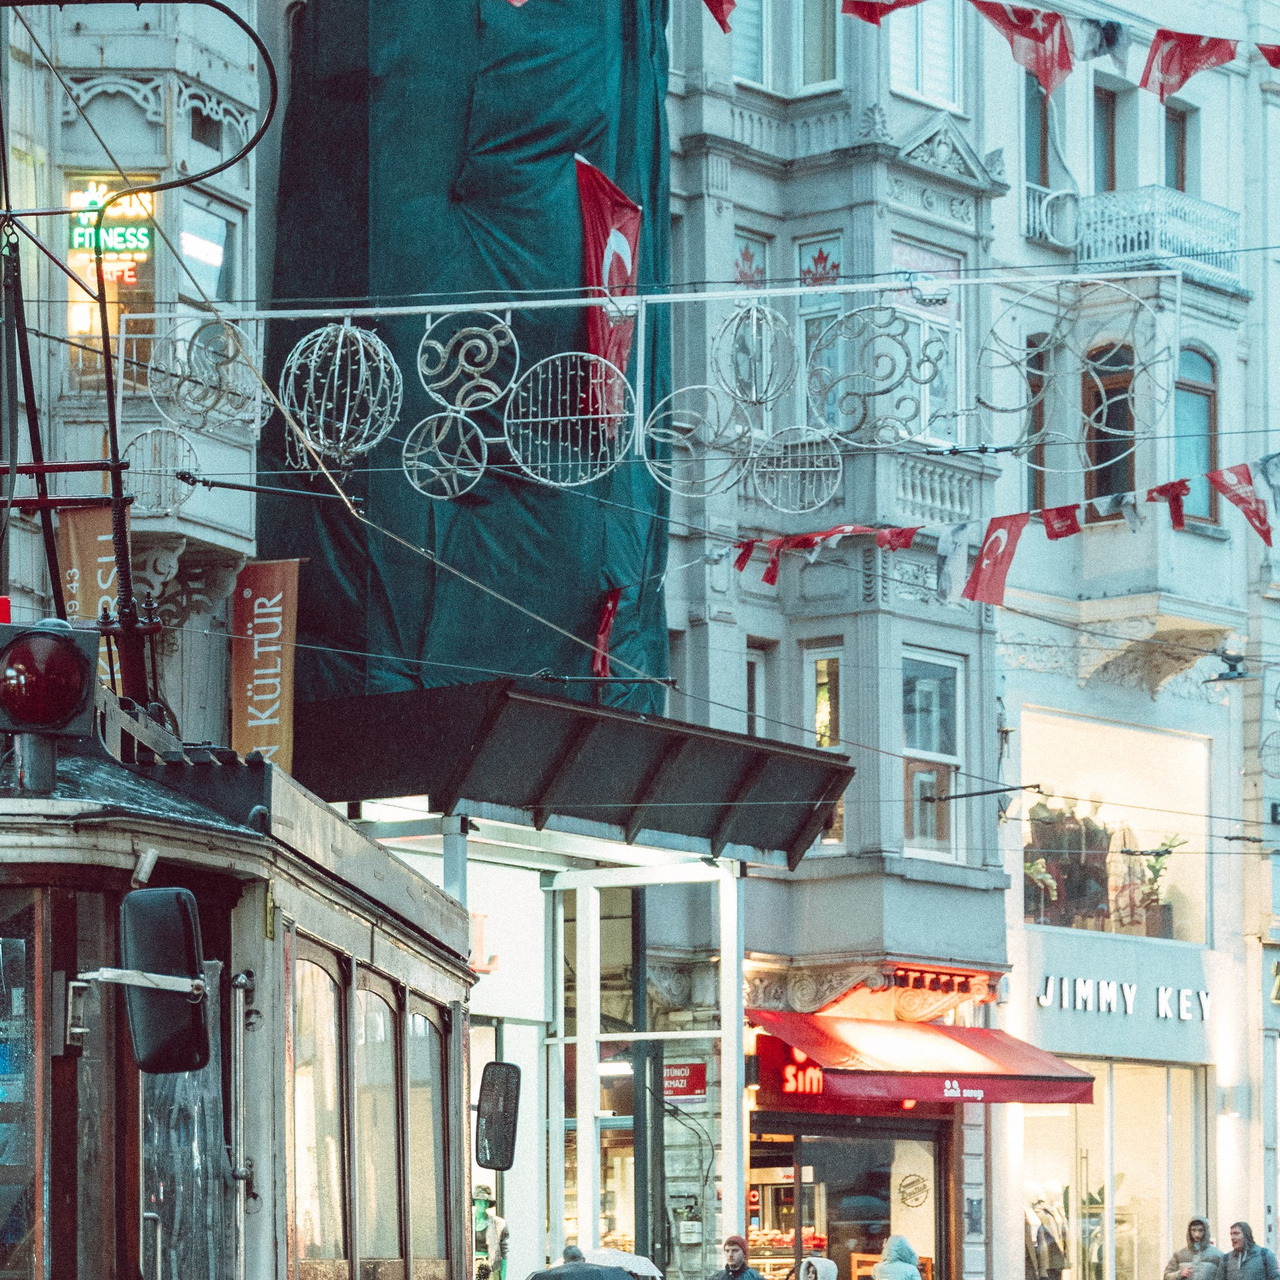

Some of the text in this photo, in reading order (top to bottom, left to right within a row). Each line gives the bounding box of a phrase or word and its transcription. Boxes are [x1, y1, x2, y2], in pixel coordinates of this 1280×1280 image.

[72, 226, 150, 250] FITNESS
[65, 568, 80, 593] 43
[247, 591, 283, 727] KÜLTÜR
[1037, 976, 1212, 1021] JIMMY KEY
[663, 1079, 687, 1088] KMAZI
